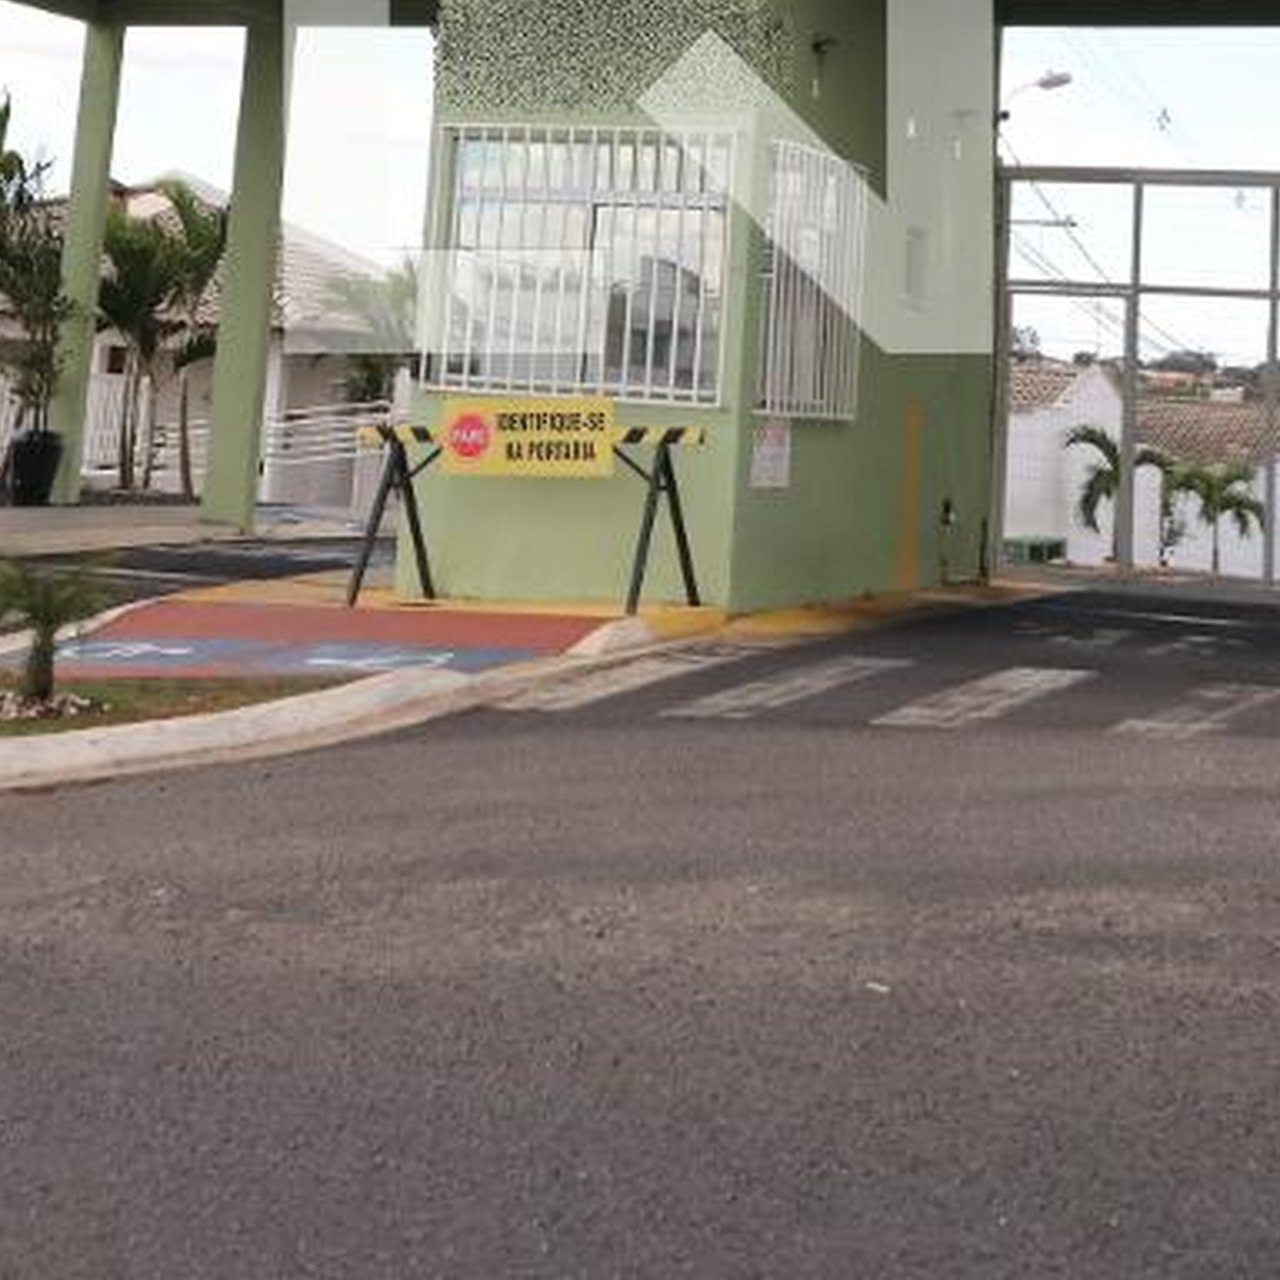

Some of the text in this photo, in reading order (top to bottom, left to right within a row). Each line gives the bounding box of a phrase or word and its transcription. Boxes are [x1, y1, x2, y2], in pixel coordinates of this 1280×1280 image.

[496, 412, 605, 431] IDENTIFIQUE-SE
[506, 441, 596, 460] NA PORTARIA
